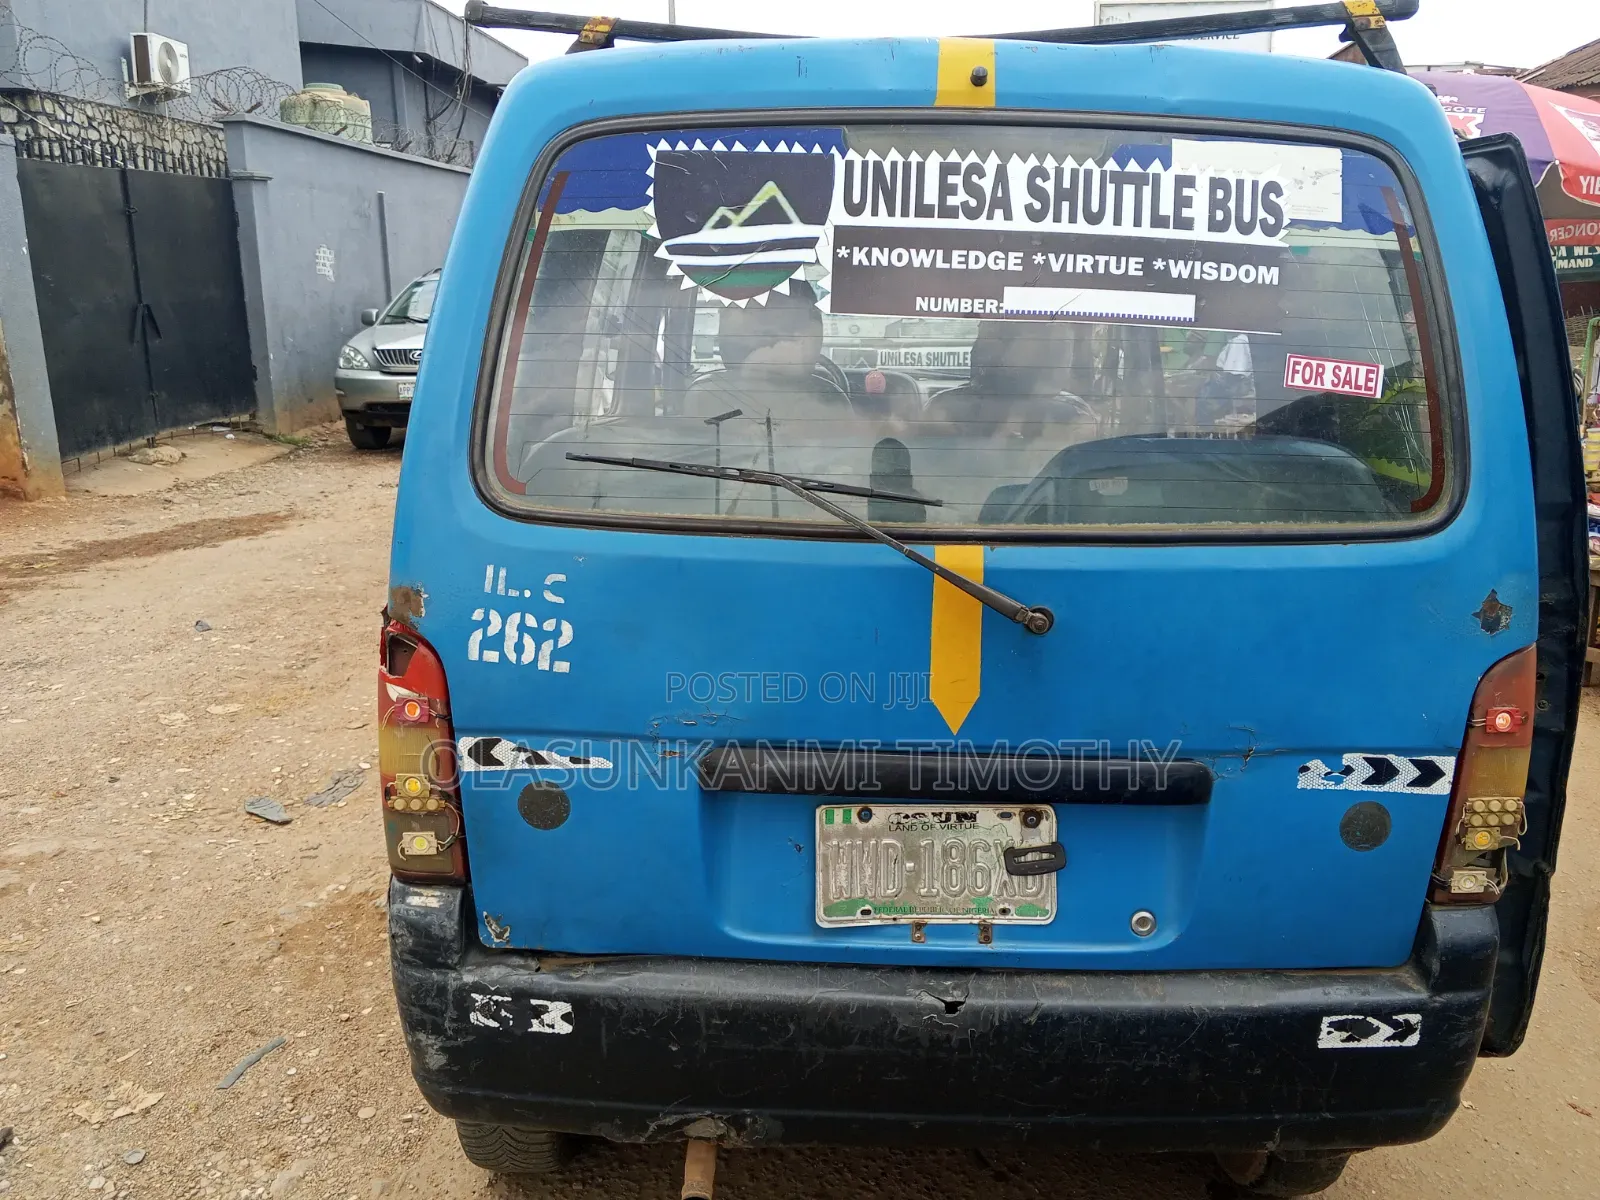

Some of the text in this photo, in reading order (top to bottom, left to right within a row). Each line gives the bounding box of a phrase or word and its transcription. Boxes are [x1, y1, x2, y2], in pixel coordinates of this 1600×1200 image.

[843, 159, 1285, 238] UNILESA SHUTTLE BUS
[880, 351, 968, 366] UNILESA SHUTTLE
[1291, 361, 1375, 391] FOR SALE
[467, 607, 574, 673] 262
[889, 824, 918, 832] LAND
[921, 824, 936, 832] OF
[874, 906, 907, 914] FEDERAL
[962, 907, 995, 915] NIGERIA
